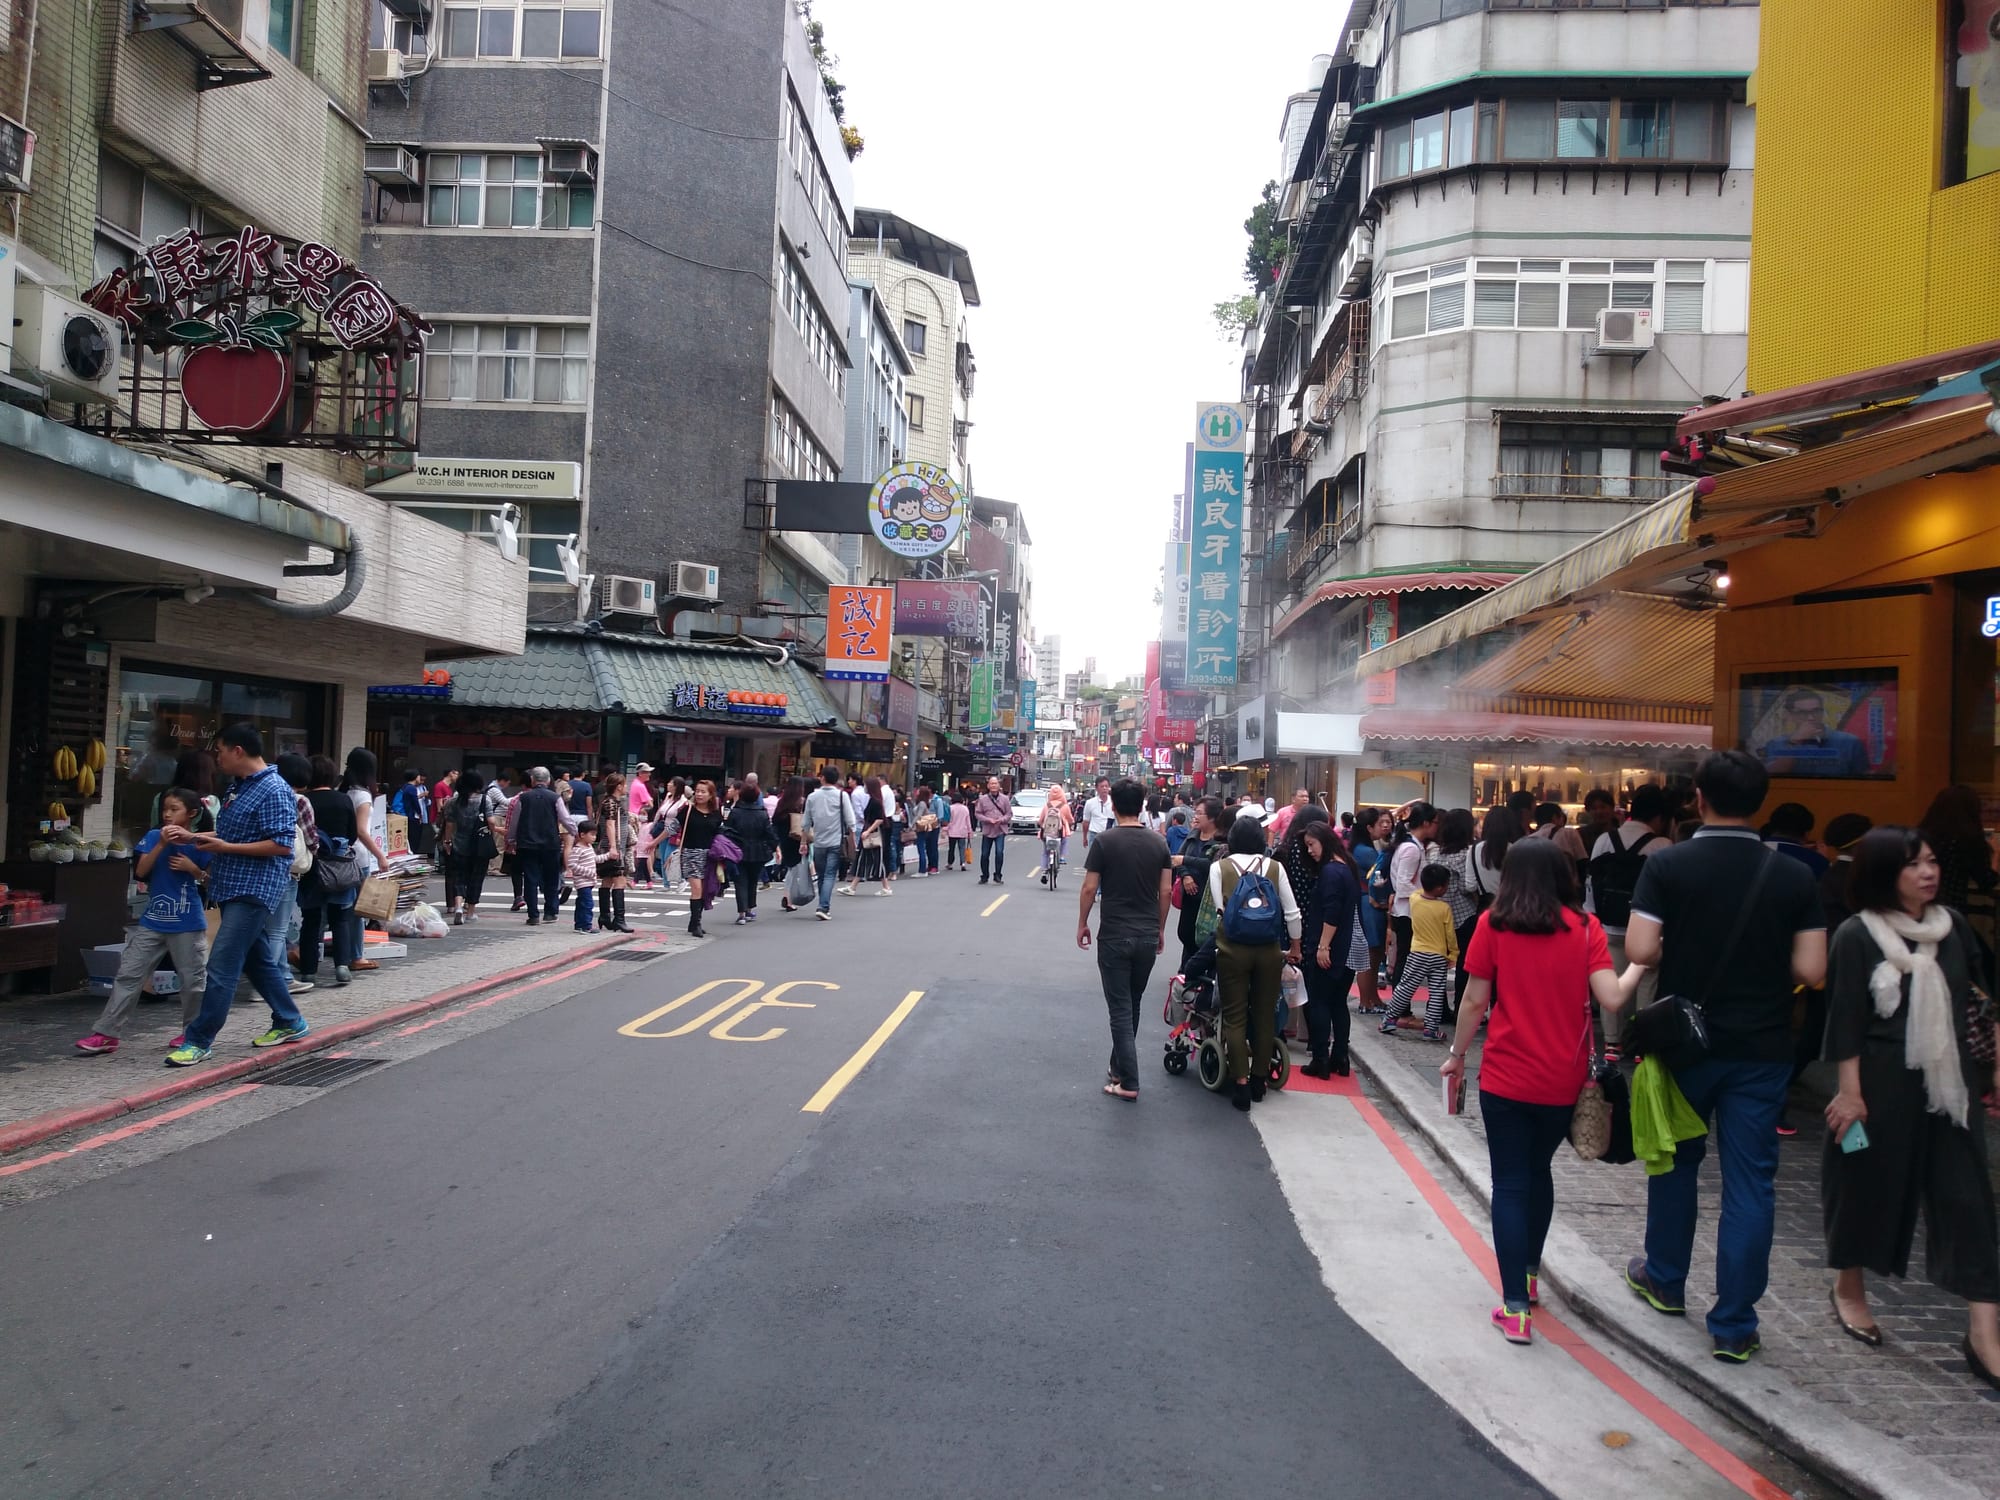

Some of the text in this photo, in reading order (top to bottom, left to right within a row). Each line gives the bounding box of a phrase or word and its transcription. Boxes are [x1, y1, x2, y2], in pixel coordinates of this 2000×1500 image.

[418, 467, 555, 480] W.C.H INTERIOR DESIGN
[918, 466, 945, 486] Hello
[883, 523, 945, 541] 收藏天地
[1194, 468, 1239, 673] 誠良牙醫診所
[840, 591, 877, 656] 誠記
[1189, 675, 1234, 684] 2393-6306
